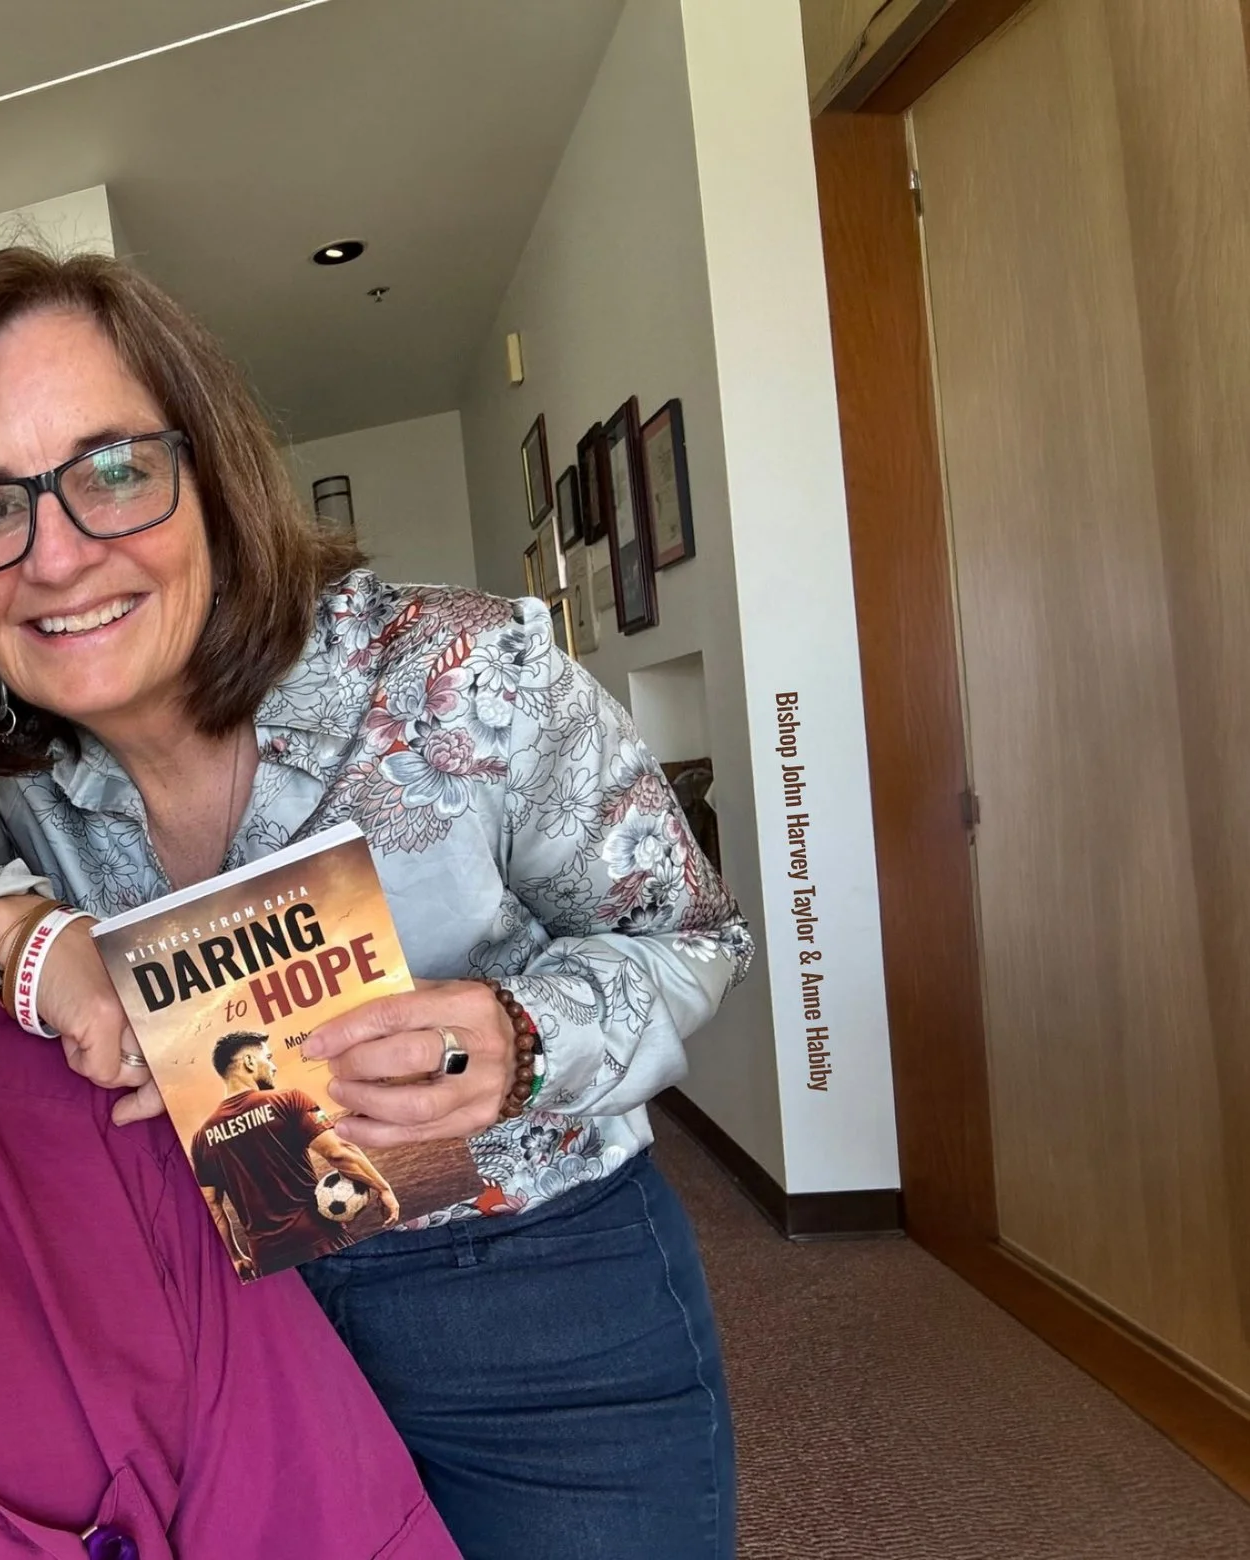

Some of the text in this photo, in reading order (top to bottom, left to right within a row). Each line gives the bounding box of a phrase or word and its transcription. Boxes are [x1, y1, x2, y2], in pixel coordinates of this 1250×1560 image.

[125, 886, 309, 963] WITNESS FROM GAZA
[131, 902, 326, 1013] DARING
[17, 925, 53, 1028] PALESTINE
[224, 933, 386, 1025] to HOPE
[205, 1103, 275, 1147] PALESTINE
